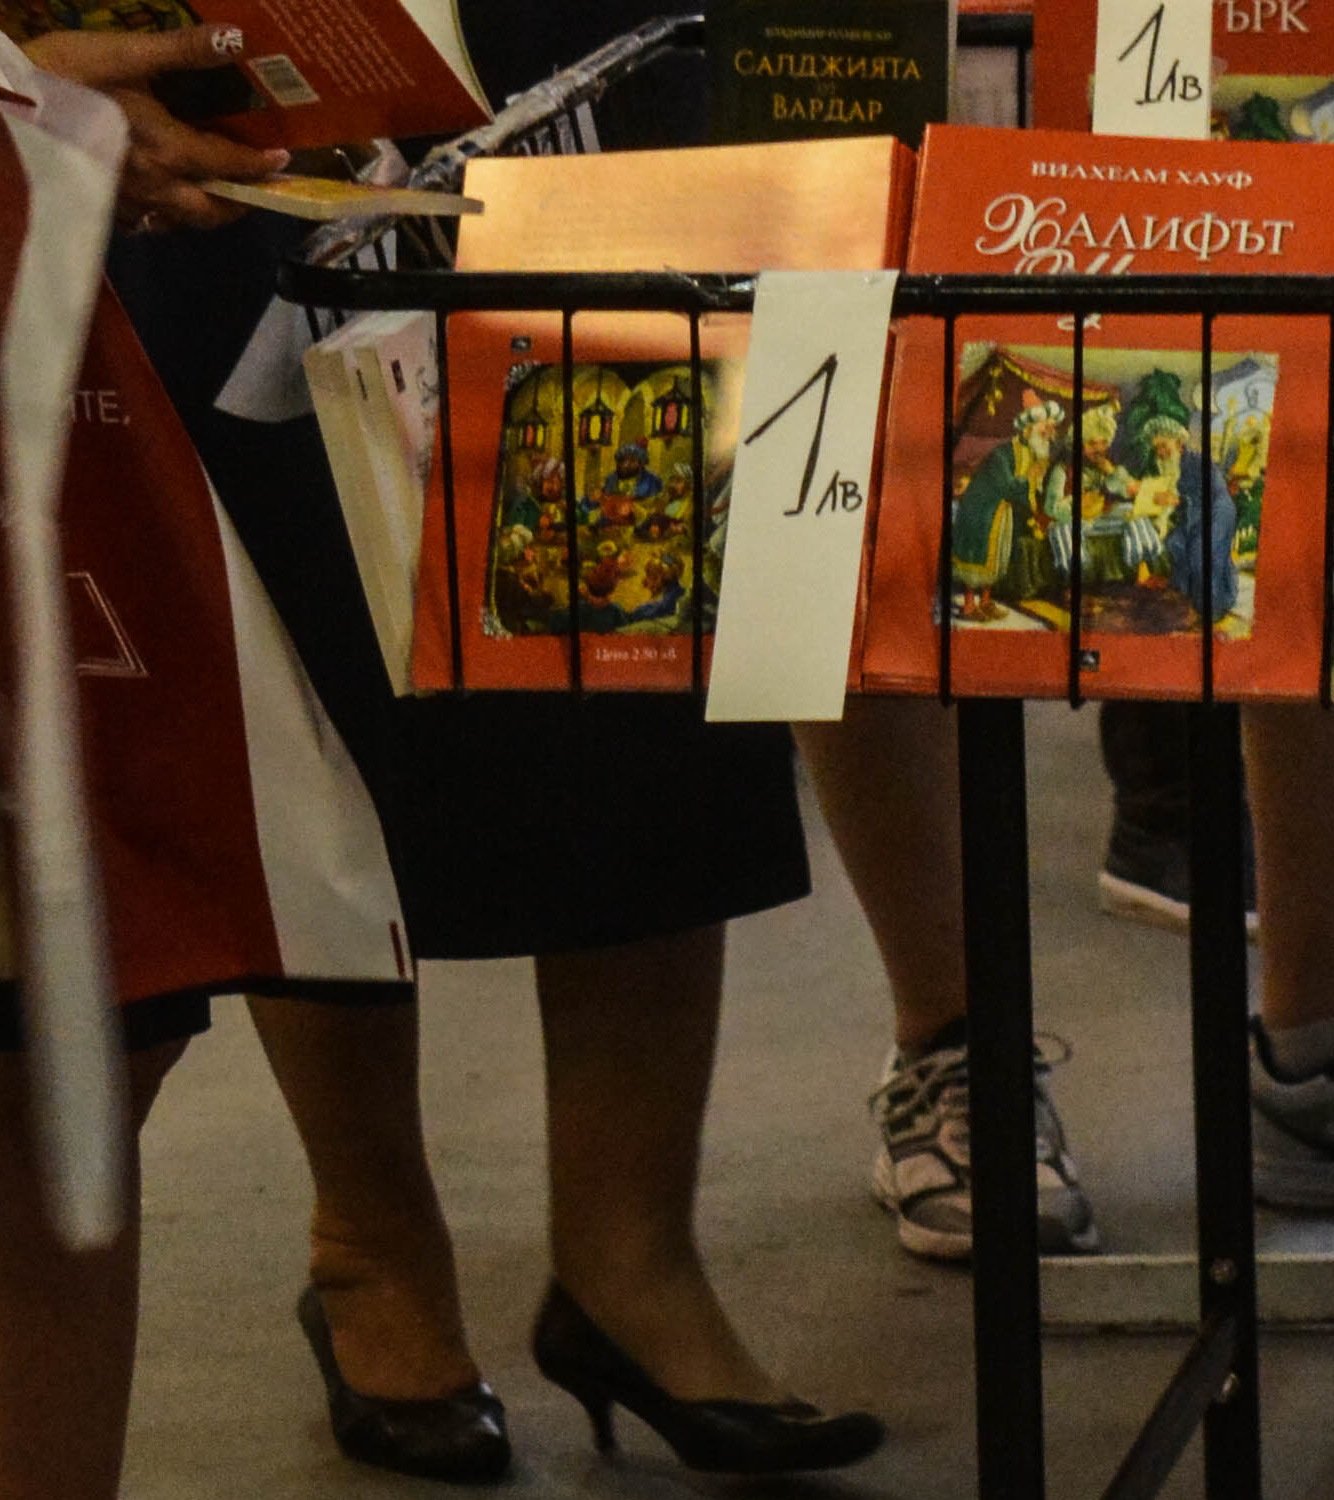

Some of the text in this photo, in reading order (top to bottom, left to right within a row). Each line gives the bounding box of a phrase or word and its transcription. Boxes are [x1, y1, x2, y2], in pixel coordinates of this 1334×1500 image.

[734, 48, 922, 80] САЛДЖИЯТА
[772, 92, 883, 123] ВАРДАР
[1031, 159, 1253, 191] ВИЛХЕЛМ ХАУФ
